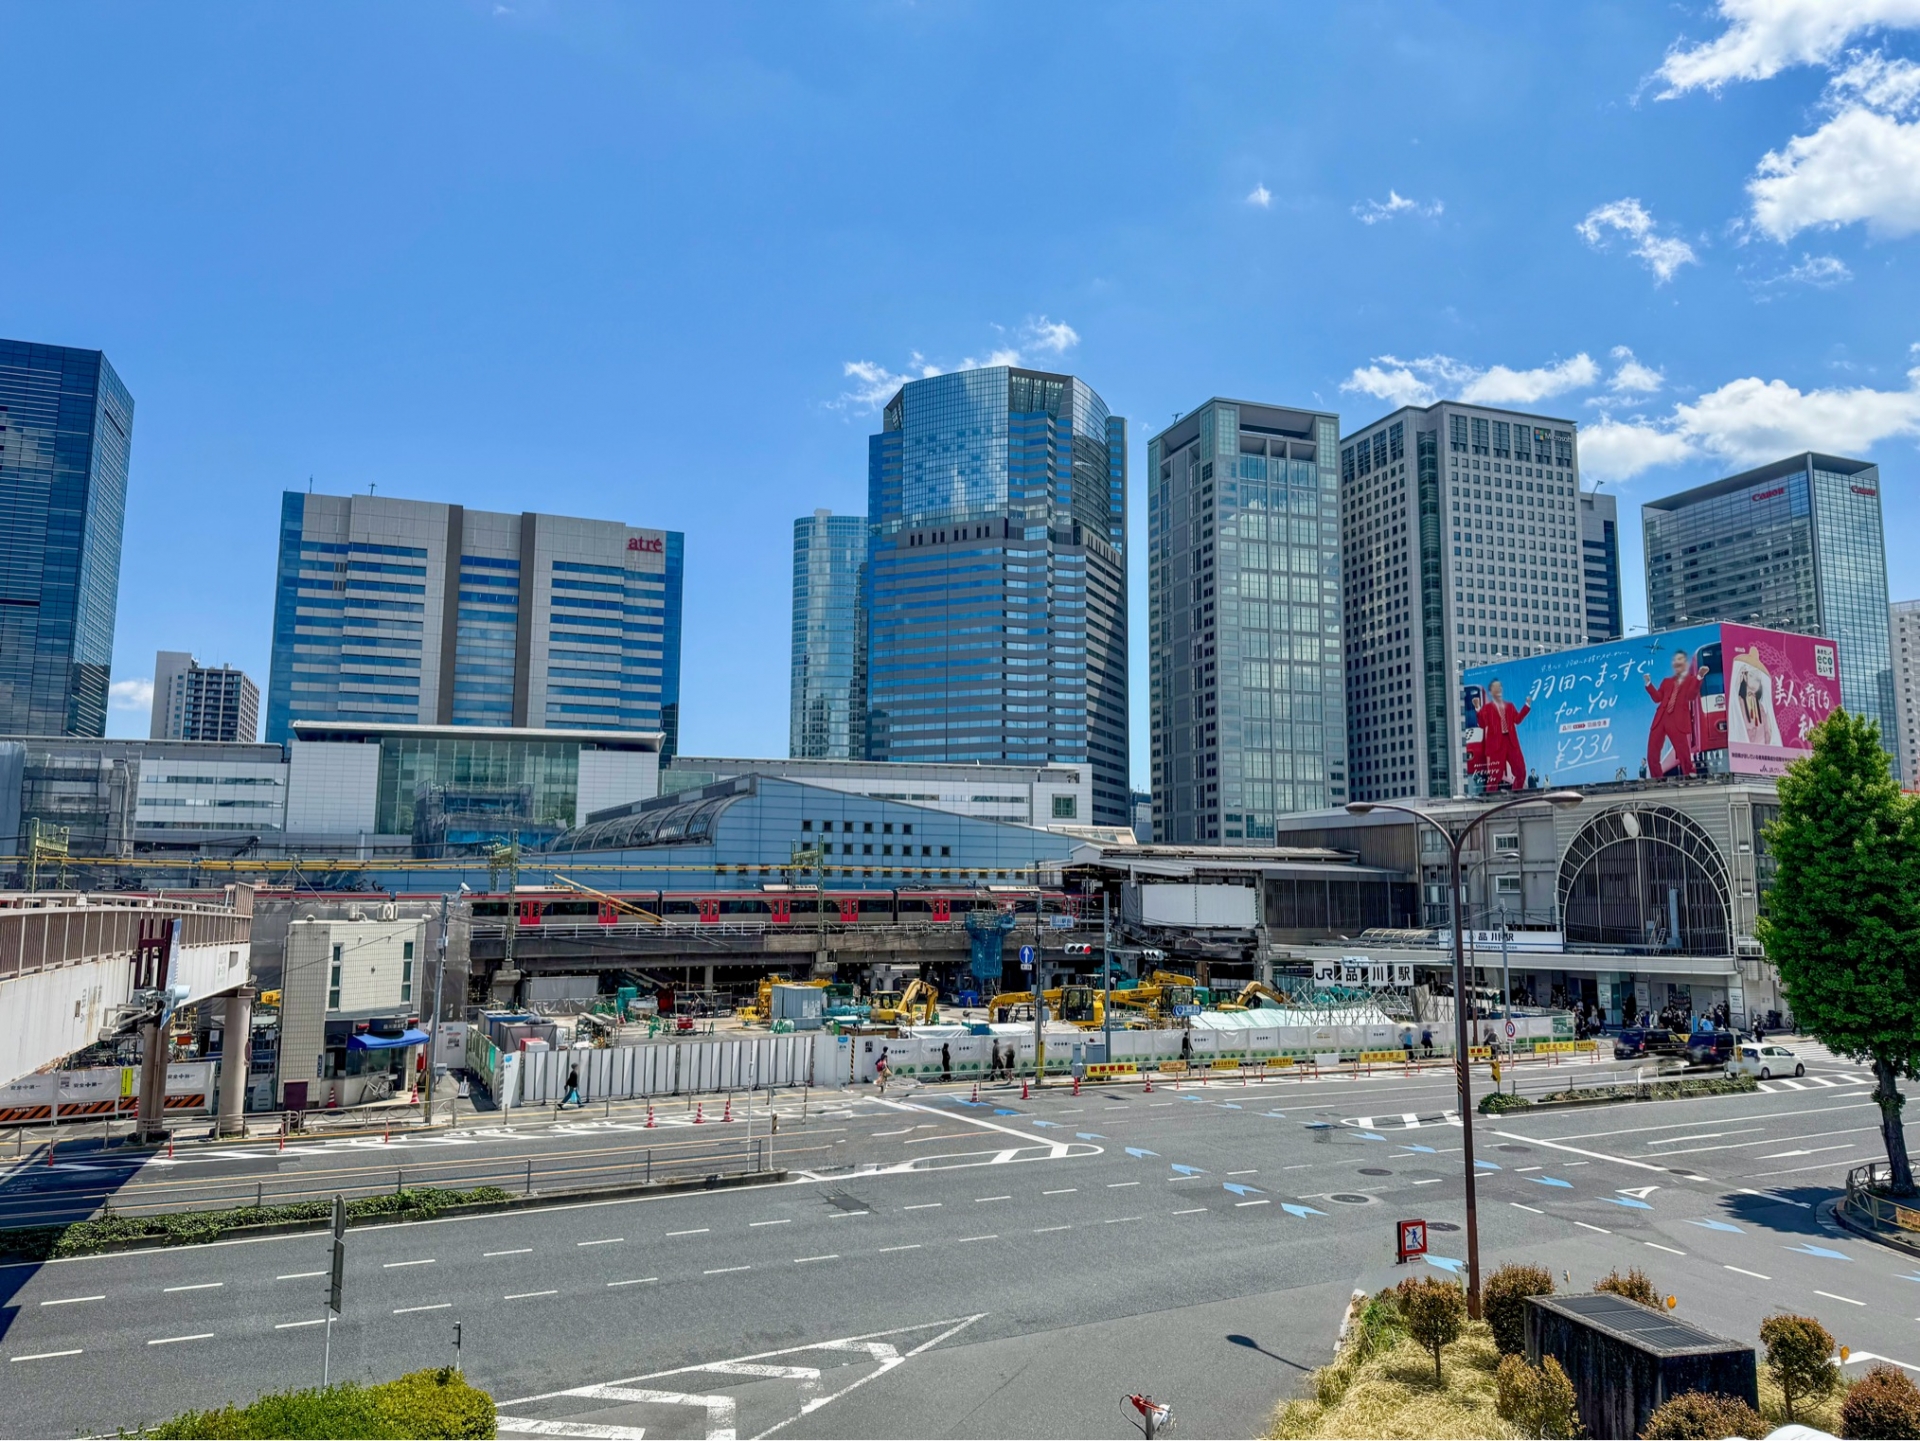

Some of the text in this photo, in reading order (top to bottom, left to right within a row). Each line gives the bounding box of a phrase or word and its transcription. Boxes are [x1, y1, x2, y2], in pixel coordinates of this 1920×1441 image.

[1544, 432, 1572, 443] Microsoft
[1752, 487, 1785, 501] Canon
[1851, 485, 1876, 497] Canon
[628, 536, 662, 553] atré
[1817, 655, 1833, 666] eco
[1529, 658, 1654, 701] 羽田へまっすぐ
[1775, 674, 1830, 711] 美人を育てる
[1555, 701, 1582, 723] for
[1555, 733, 1614, 769] ¥330
[1690, 750, 1723, 762] KEIKYU
[1315, 966, 1411, 982] JR 品川駅
